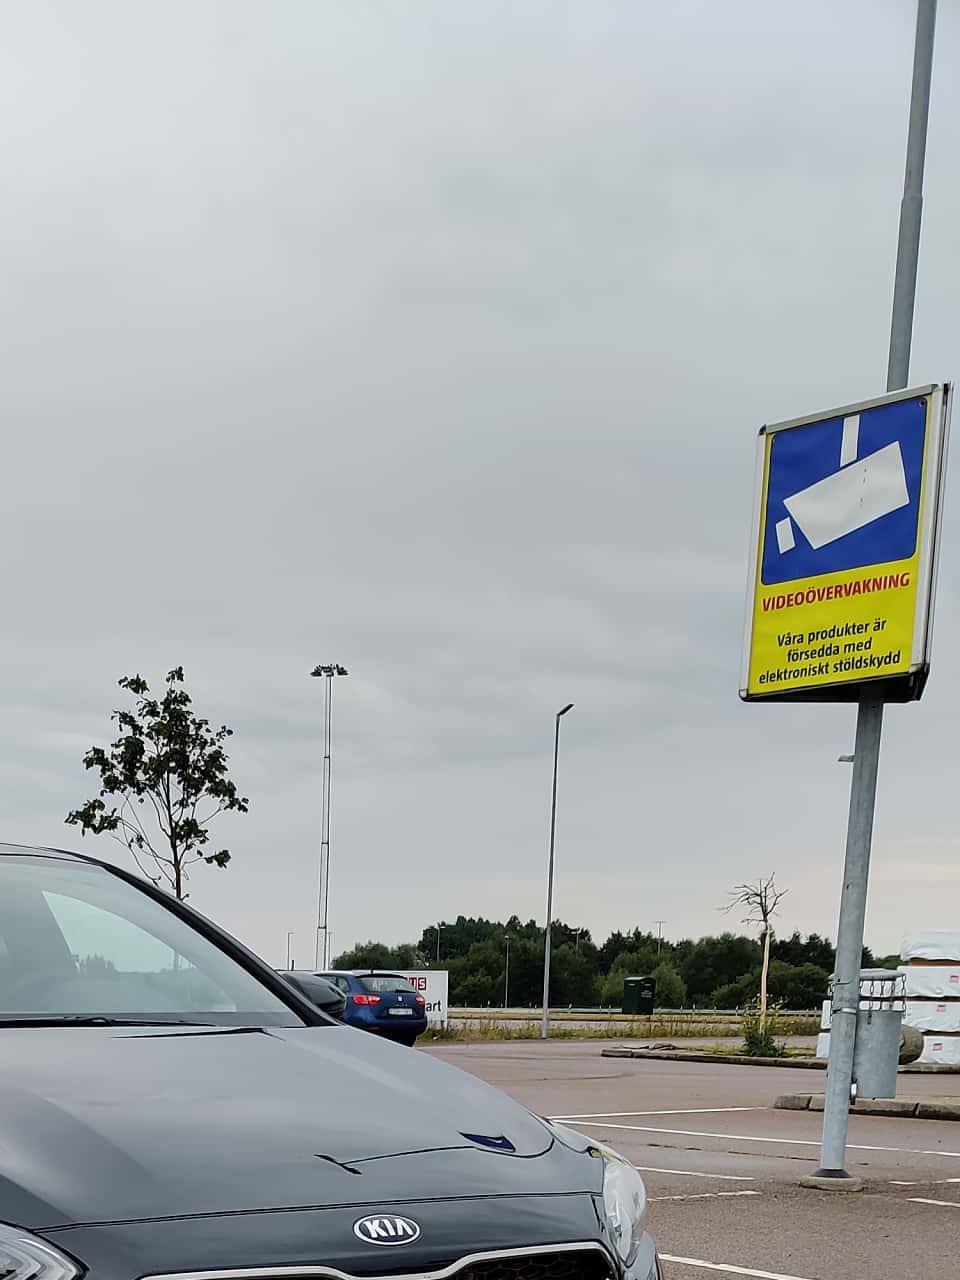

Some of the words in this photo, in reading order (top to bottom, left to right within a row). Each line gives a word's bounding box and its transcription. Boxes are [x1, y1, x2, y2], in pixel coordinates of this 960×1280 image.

[762, 572, 910, 612] VIDEOÖVERVAKNING
[777, 632, 804, 647] Våra
[807, 622, 870, 645] produkter
[873, 618, 887, 632] är
[787, 643, 840, 663] försedda
[843, 637, 872, 655] med
[759, 662, 830, 684] elektroniskt
[833, 650, 901, 673] stöldskydd
[363, 1218, 414, 1238] KIA
